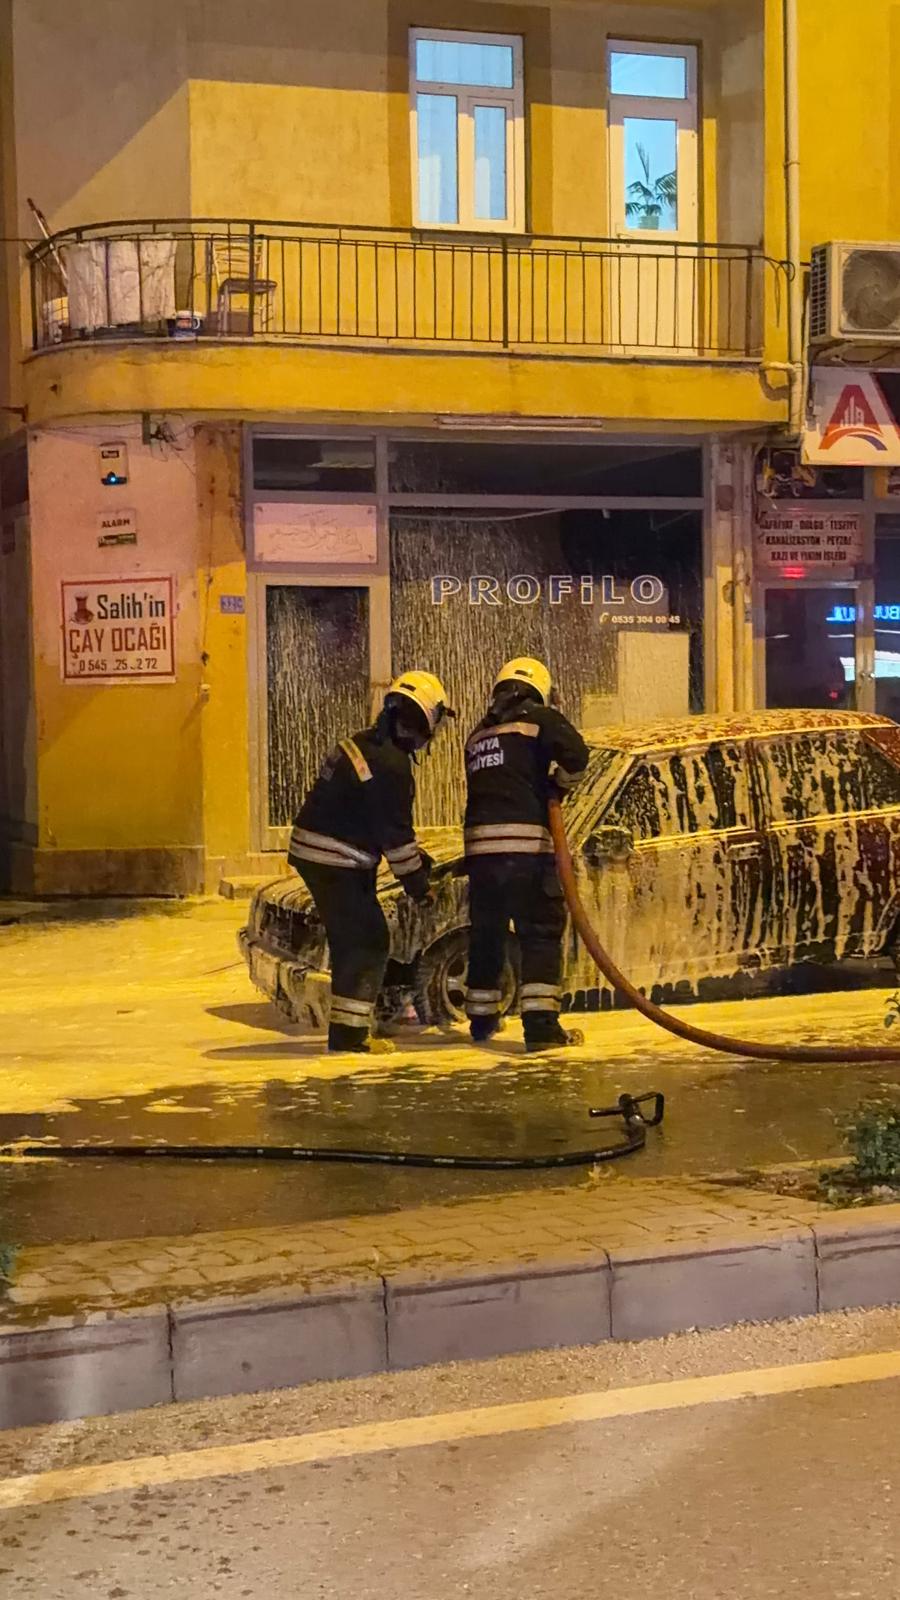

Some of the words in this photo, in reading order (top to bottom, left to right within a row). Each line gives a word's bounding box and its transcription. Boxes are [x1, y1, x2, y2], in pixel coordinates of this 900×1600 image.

[101, 518, 131, 529] ALARM
[765, 534, 821, 546] KANALİZASYON
[96, 592, 166, 621] Salih'in
[611, 615, 634, 624] 0535
[636, 615, 653, 624] 304
[668, 615, 681, 624] 45
[69, 628, 105, 659] ÇAY
[111, 623, 167, 653] OCAĞI
[88, 659, 108, 672] 545
